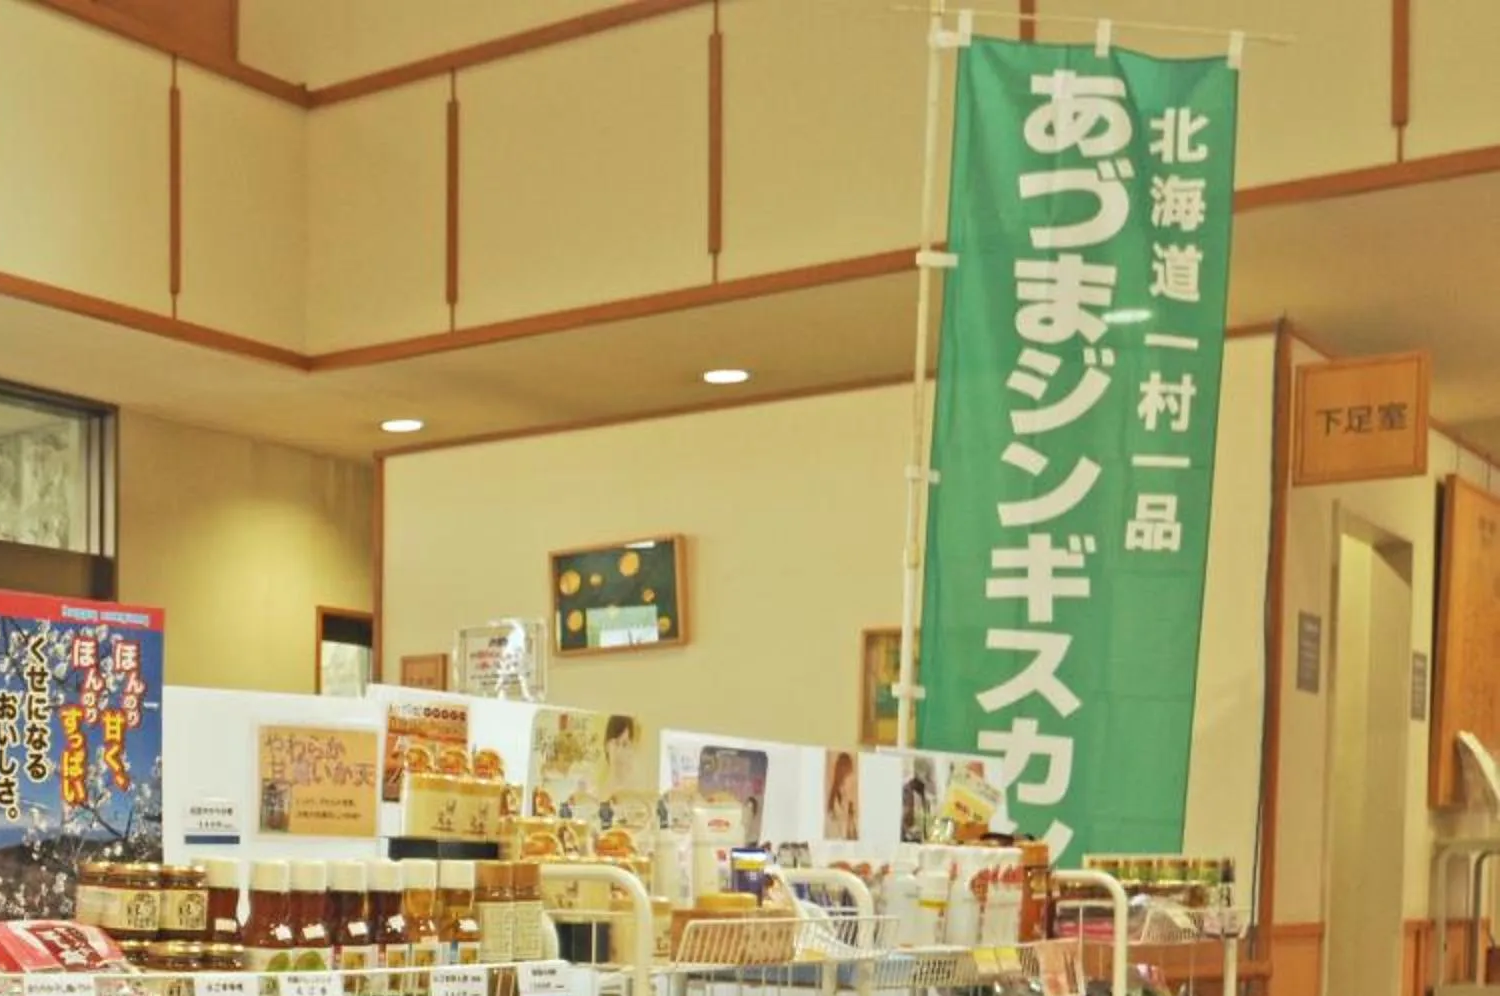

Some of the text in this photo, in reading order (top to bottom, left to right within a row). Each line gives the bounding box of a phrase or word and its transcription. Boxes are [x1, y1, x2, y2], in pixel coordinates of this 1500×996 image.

[1124, 106, 1208, 552] 北海道一村一品
[1316, 402, 1408, 434] 下足室
[25, 635, 51, 781] くせになる
